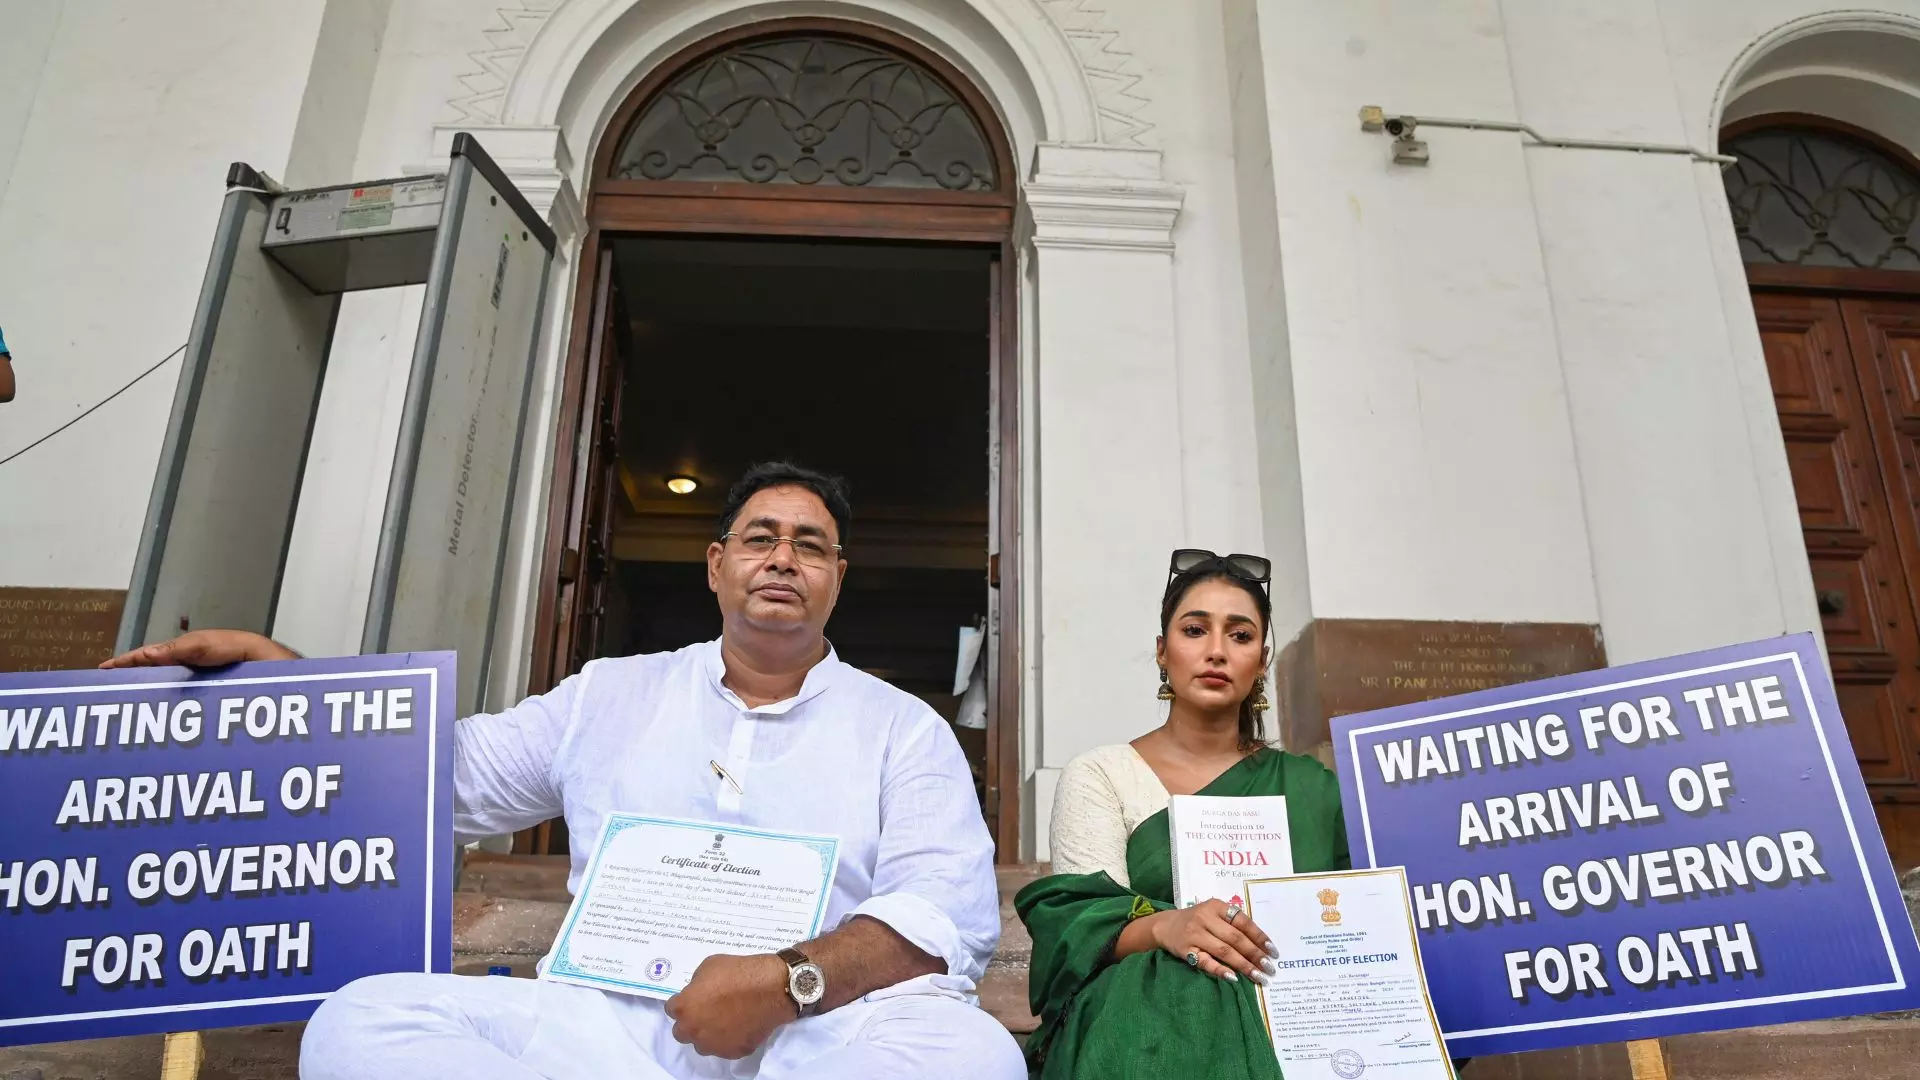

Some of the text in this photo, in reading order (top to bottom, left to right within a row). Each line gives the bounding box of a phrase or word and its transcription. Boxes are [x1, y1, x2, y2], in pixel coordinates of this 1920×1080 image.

[448, 415, 480, 556] Metal Detector
[1360, 677, 1379, 688] SIR
[0, 688, 413, 750] WAITING FOR THE
[1373, 675, 1790, 785] WAITING FOR THE
[55, 765, 341, 824] ARRIVAL OF
[1457, 761, 1734, 846] ARRIVAL OF
[1185, 832, 1281, 841] THE CONSTITUTION
[1200, 821, 1253, 830] Introduction
[0, 837, 396, 908] HON. GOVERNOR
[661, 855, 761, 876] Certificate of Election
[1203, 850, 1269, 866] INDIA
[1232, 870, 1258, 878] Edition
[1413, 829, 1828, 929] HON. GOVERNOR
[61, 921, 311, 986] FOR OATH
[1278, 953, 1398, 969] CERTIFICATE OF ELECTION
[1504, 921, 1760, 999] FOR OATH
